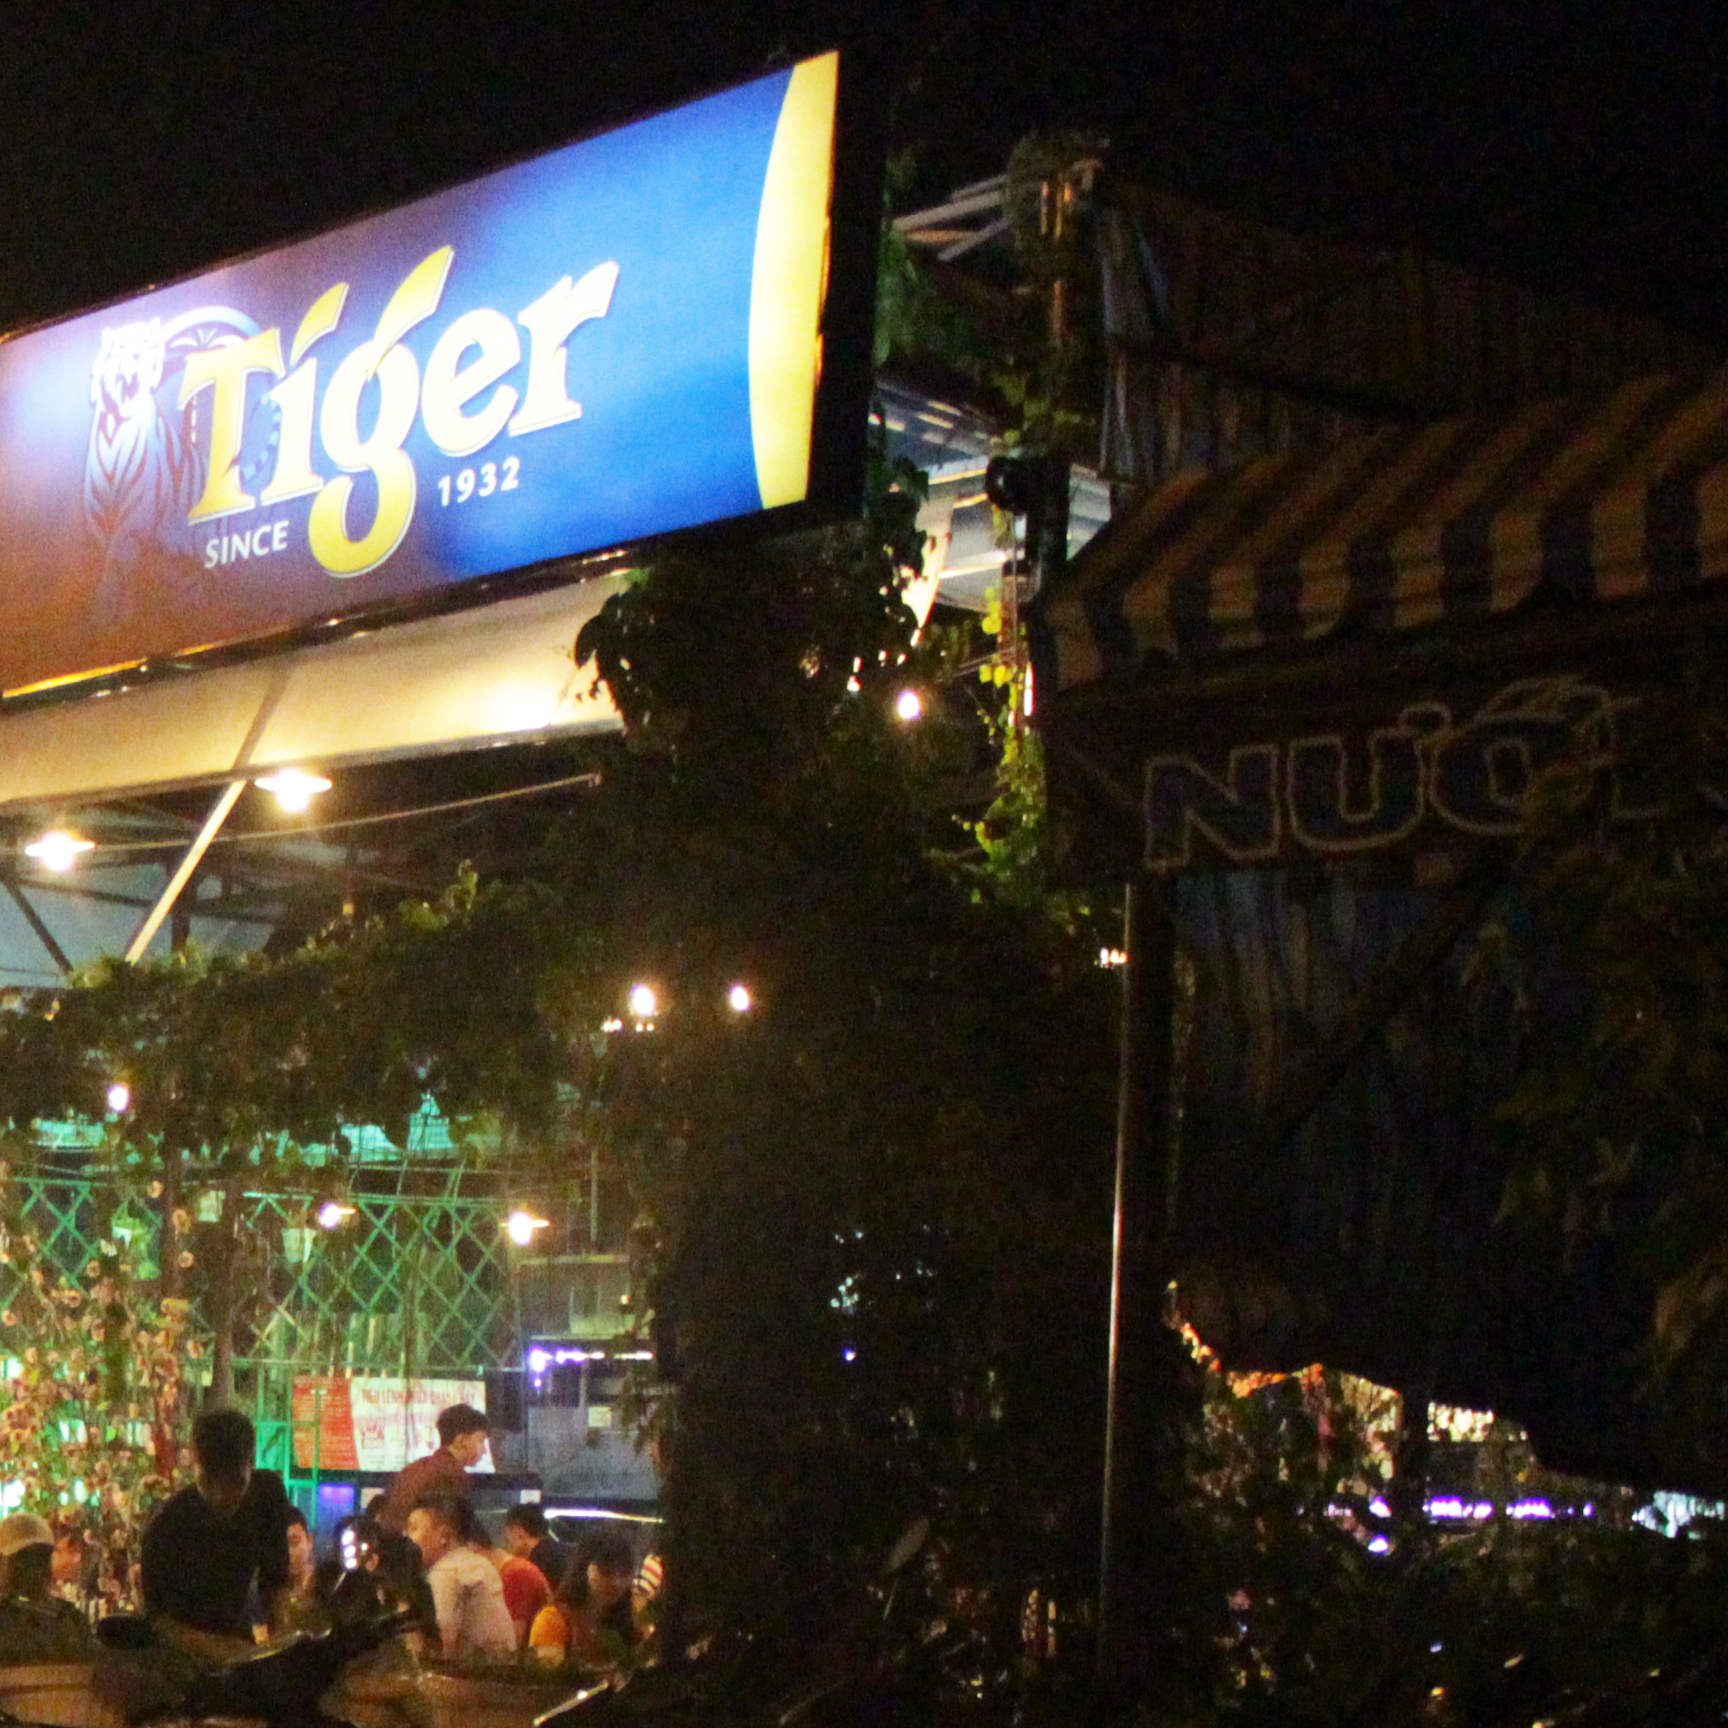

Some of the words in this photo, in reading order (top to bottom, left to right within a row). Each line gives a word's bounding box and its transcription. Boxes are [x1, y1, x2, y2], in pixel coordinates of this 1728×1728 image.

[177, 244, 620, 578] Tiger
[203, 519, 291, 570] SINCE
[438, 456, 521, 507] 1932
